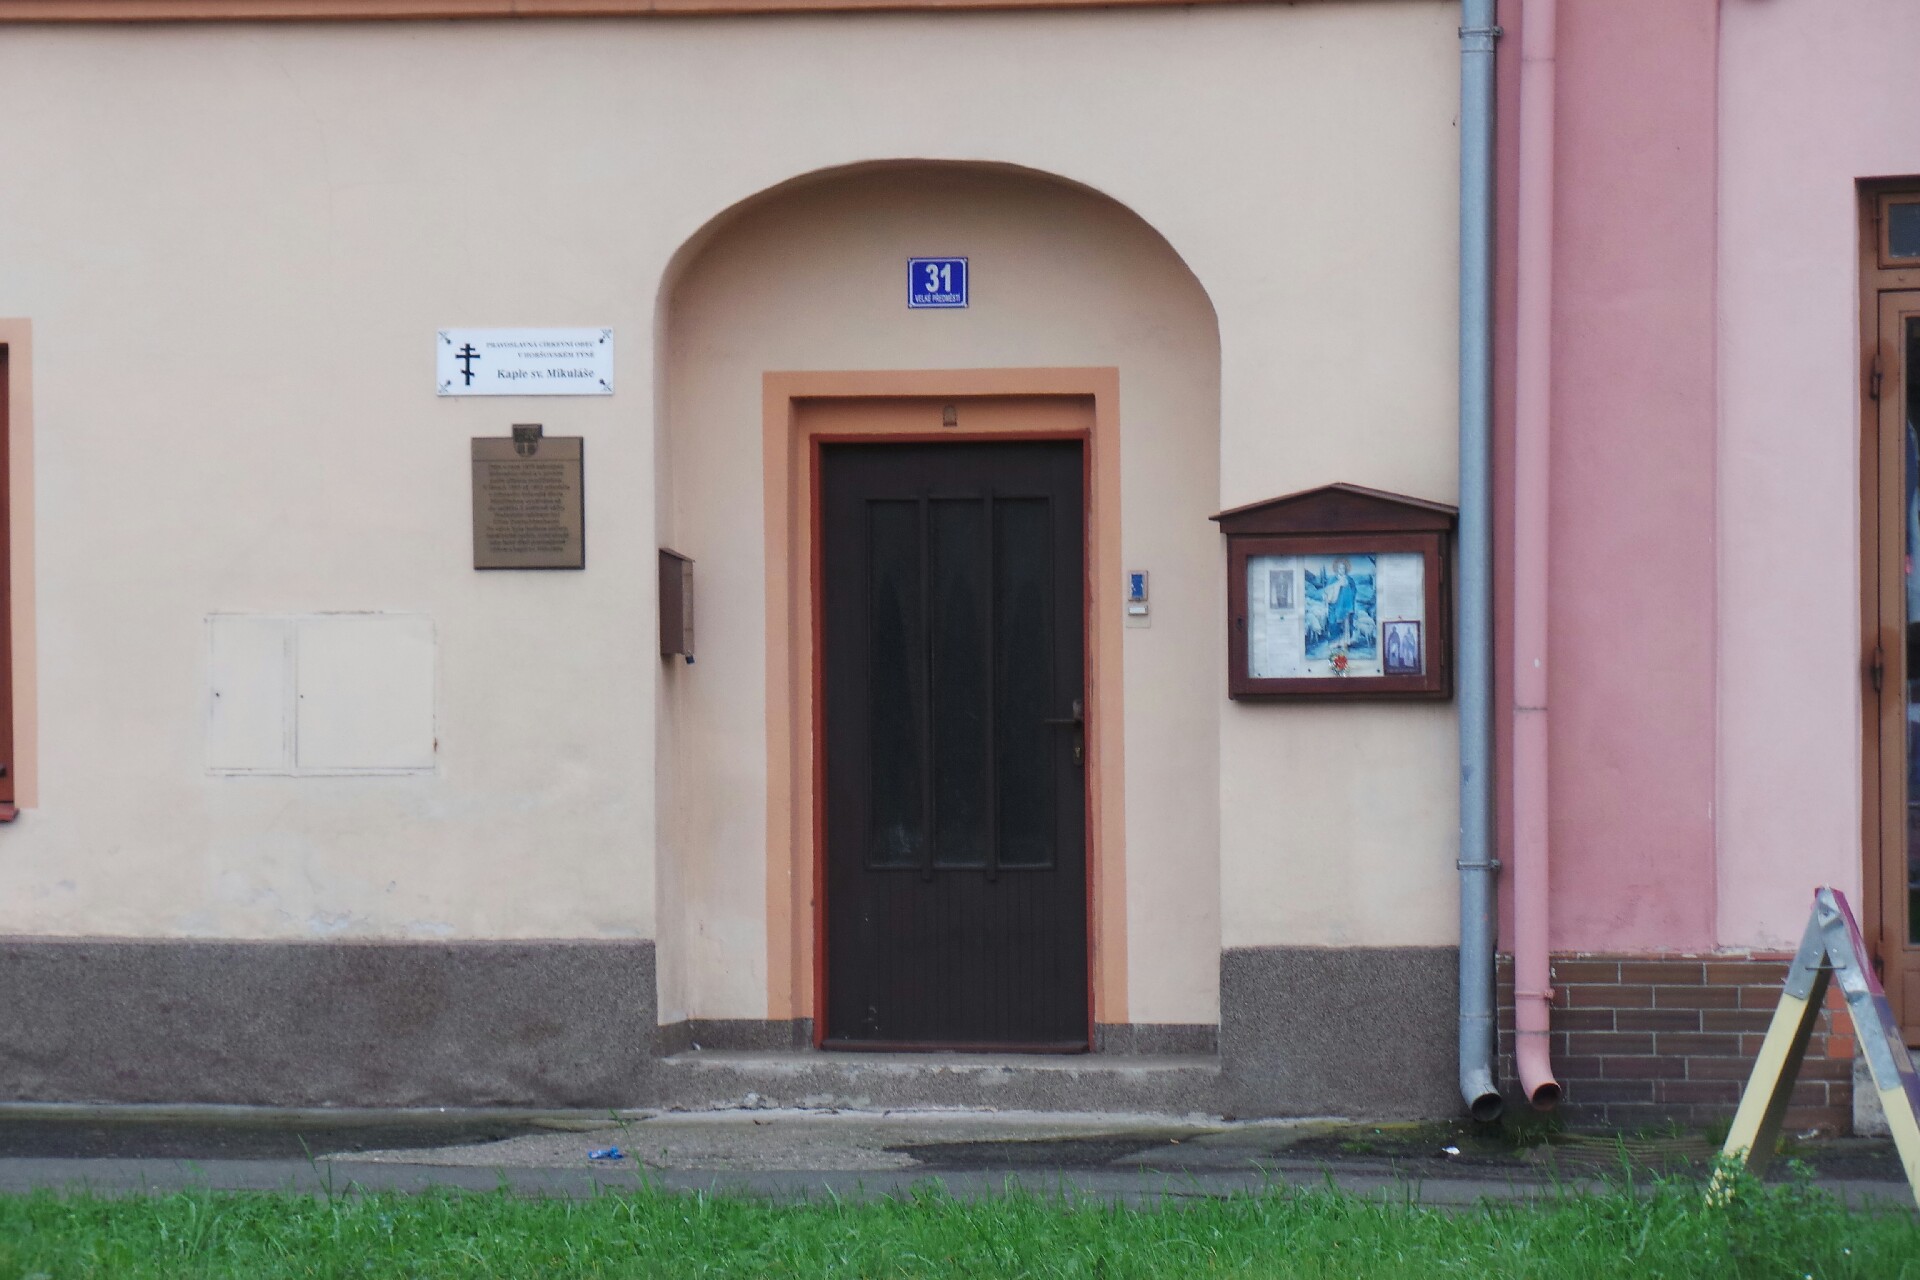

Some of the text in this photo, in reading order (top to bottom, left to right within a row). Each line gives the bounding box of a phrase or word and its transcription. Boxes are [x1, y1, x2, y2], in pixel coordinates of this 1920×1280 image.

[925, 263, 951, 293] 31
[497, 369, 528, 380] Kaple
[547, 368, 594, 378] Mikuláše
